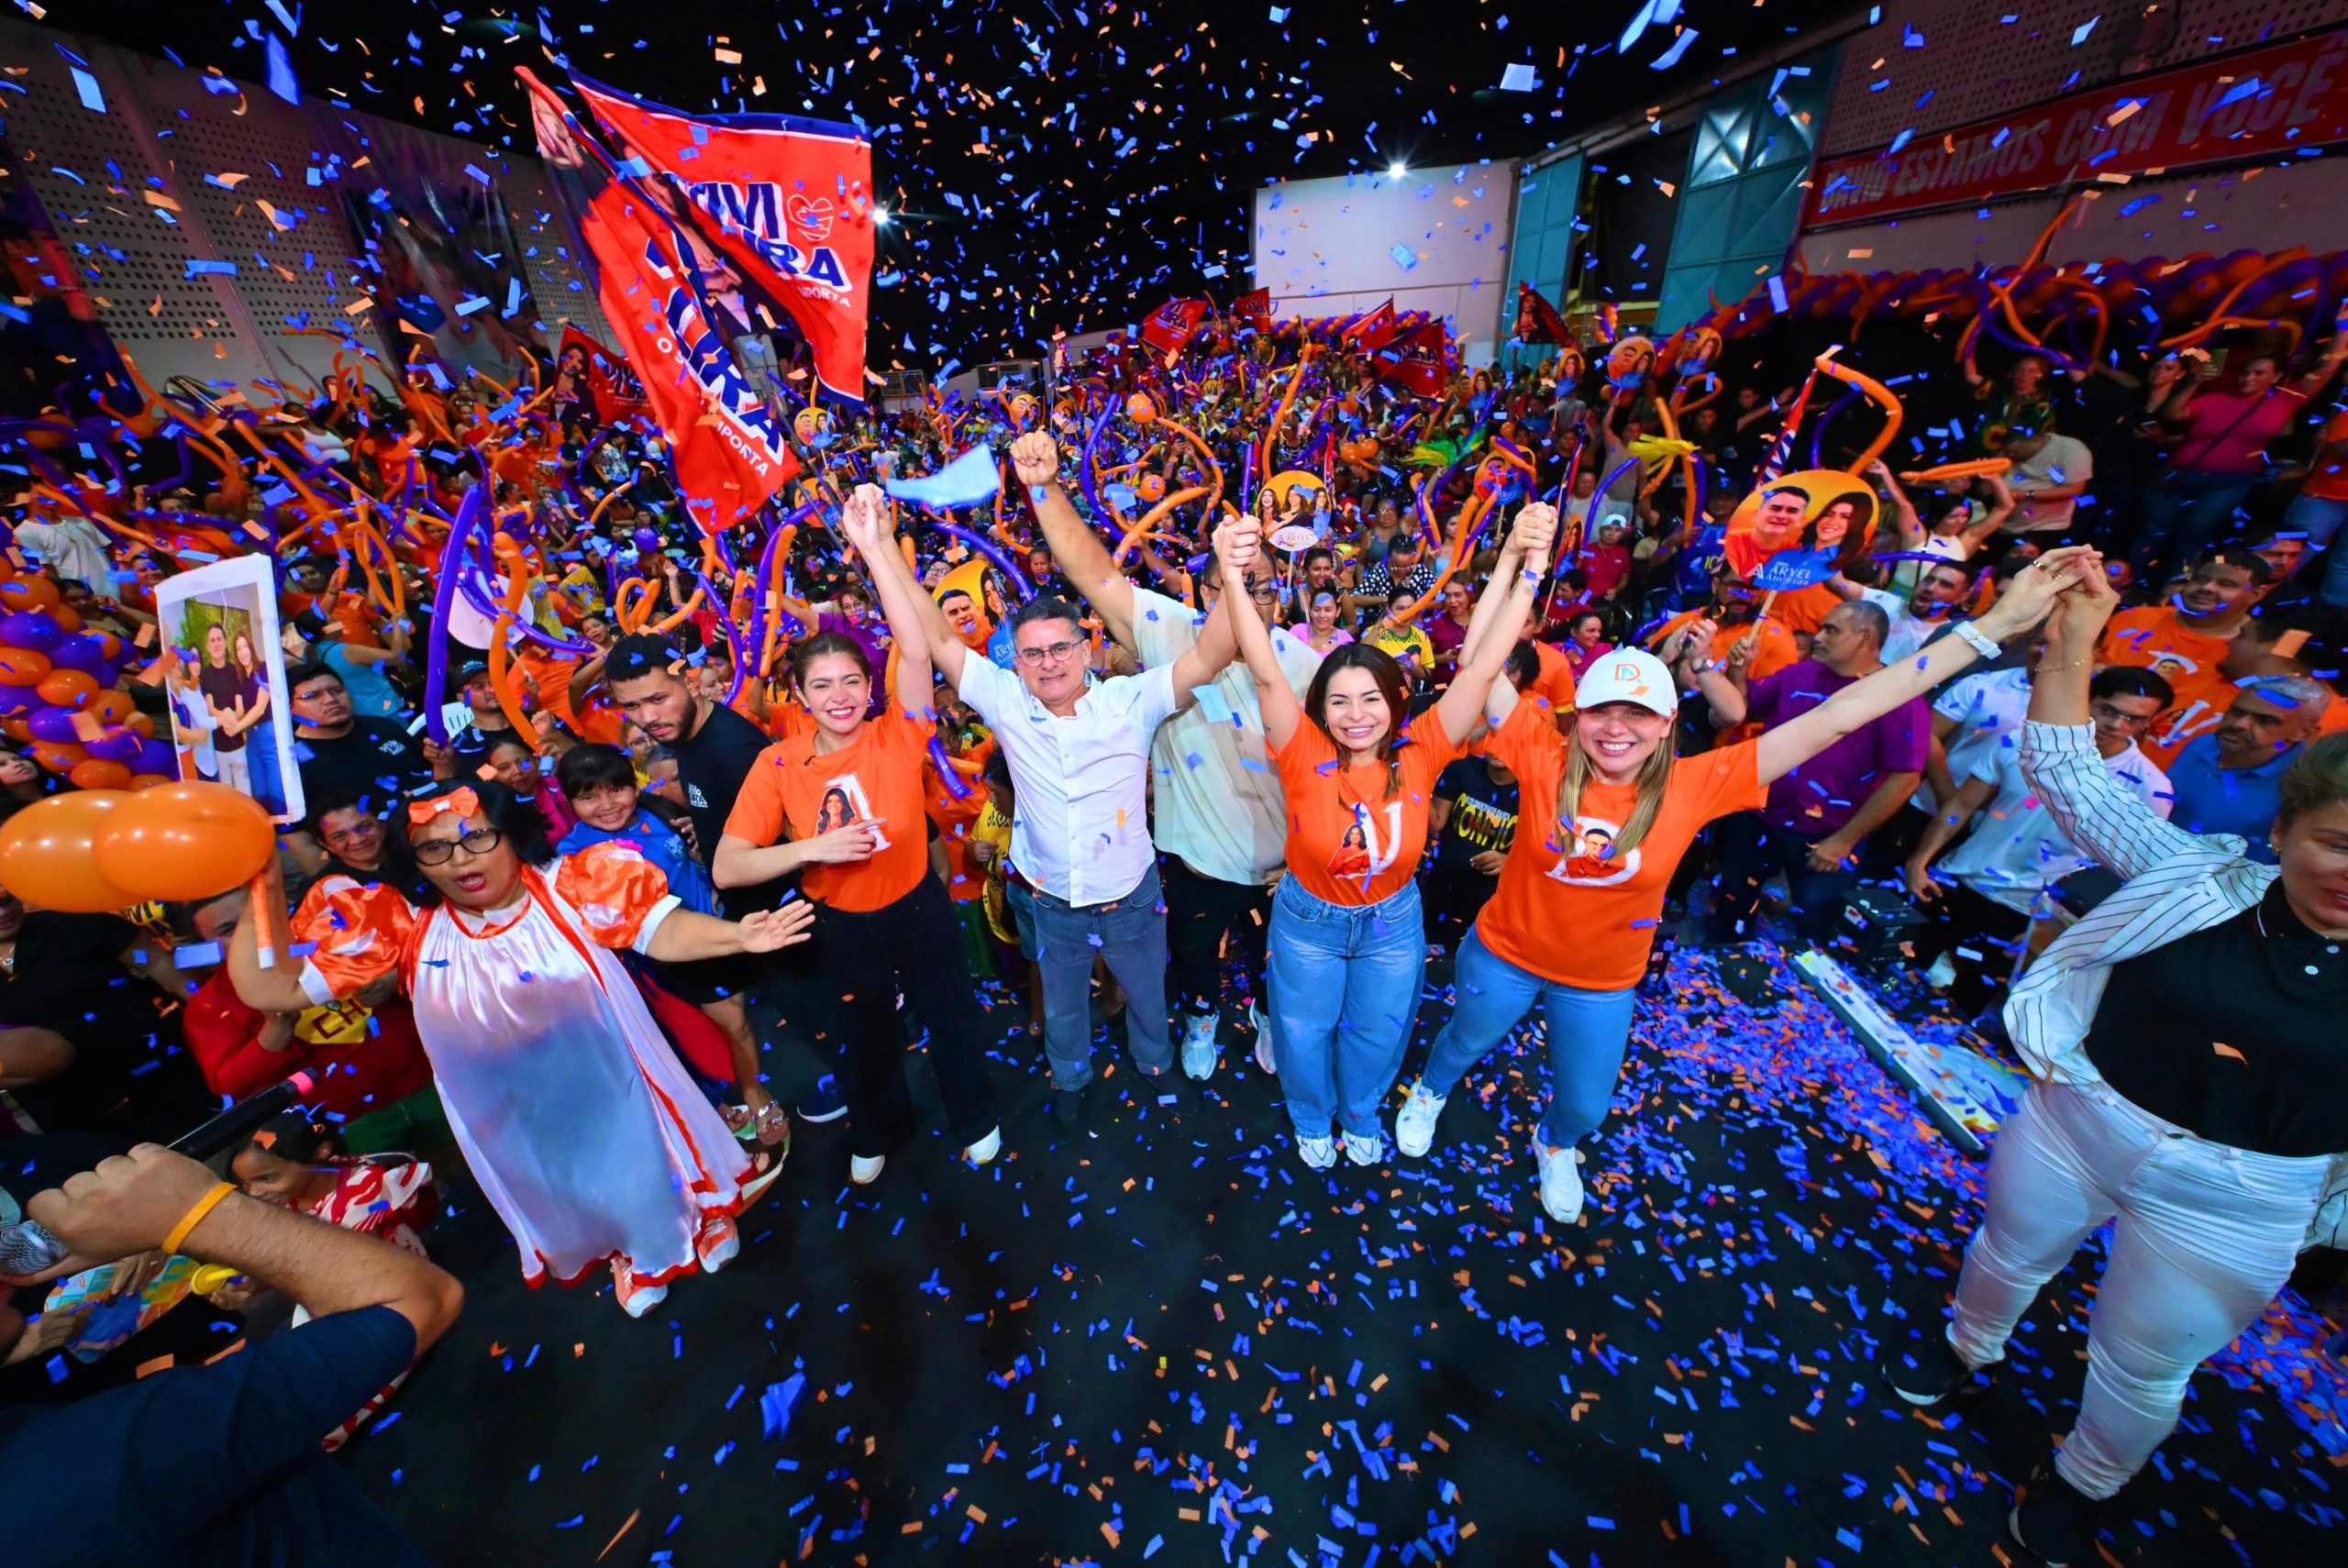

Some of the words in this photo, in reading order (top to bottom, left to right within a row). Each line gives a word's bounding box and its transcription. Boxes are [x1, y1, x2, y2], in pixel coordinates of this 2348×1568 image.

[1893, 119, 2052, 196] ESTAMOS
[2054, 90, 2175, 166] COM
[1768, 565, 1811, 580] ARYEL
